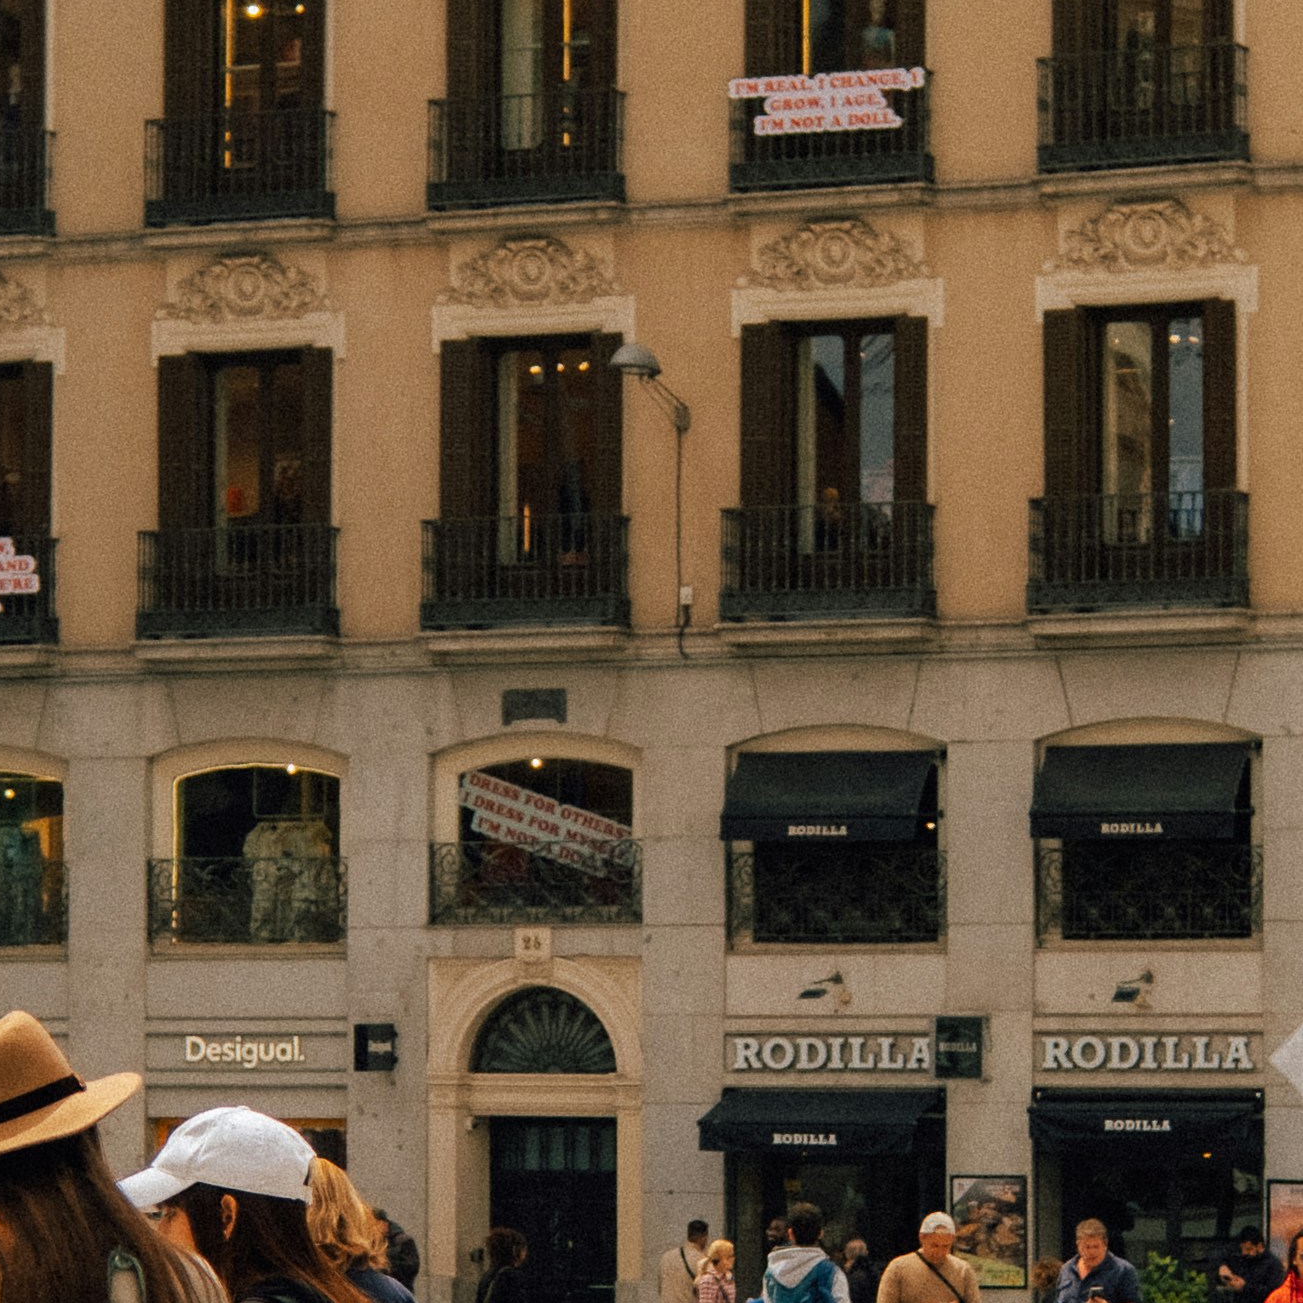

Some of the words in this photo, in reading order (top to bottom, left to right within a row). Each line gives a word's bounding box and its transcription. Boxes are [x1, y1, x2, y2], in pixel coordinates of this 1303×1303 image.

[734, 81, 759, 94] I'M
[760, 119, 784, 131] I'M
[791, 116, 824, 129] NOT
[832, 116, 842, 127] A
[469, 773, 521, 802] DRESS
[525, 792, 556, 816] FOR
[473, 795, 525, 823] DRESS
[529, 815, 560, 837] FOR
[478, 817, 501, 834] I'M
[505, 827, 539, 845] NOT
[788, 825, 848, 836] RODILLA
[1101, 823, 1164, 834] RODILLA
[185, 1035, 305, 1069] Desigual.
[733, 1036, 930, 1071] RODILLA
[1042, 1035, 1254, 1070] RODILLA
[1104, 1119, 1171, 1132] RODILLA
[773, 1133, 837, 1145] RODILLA
